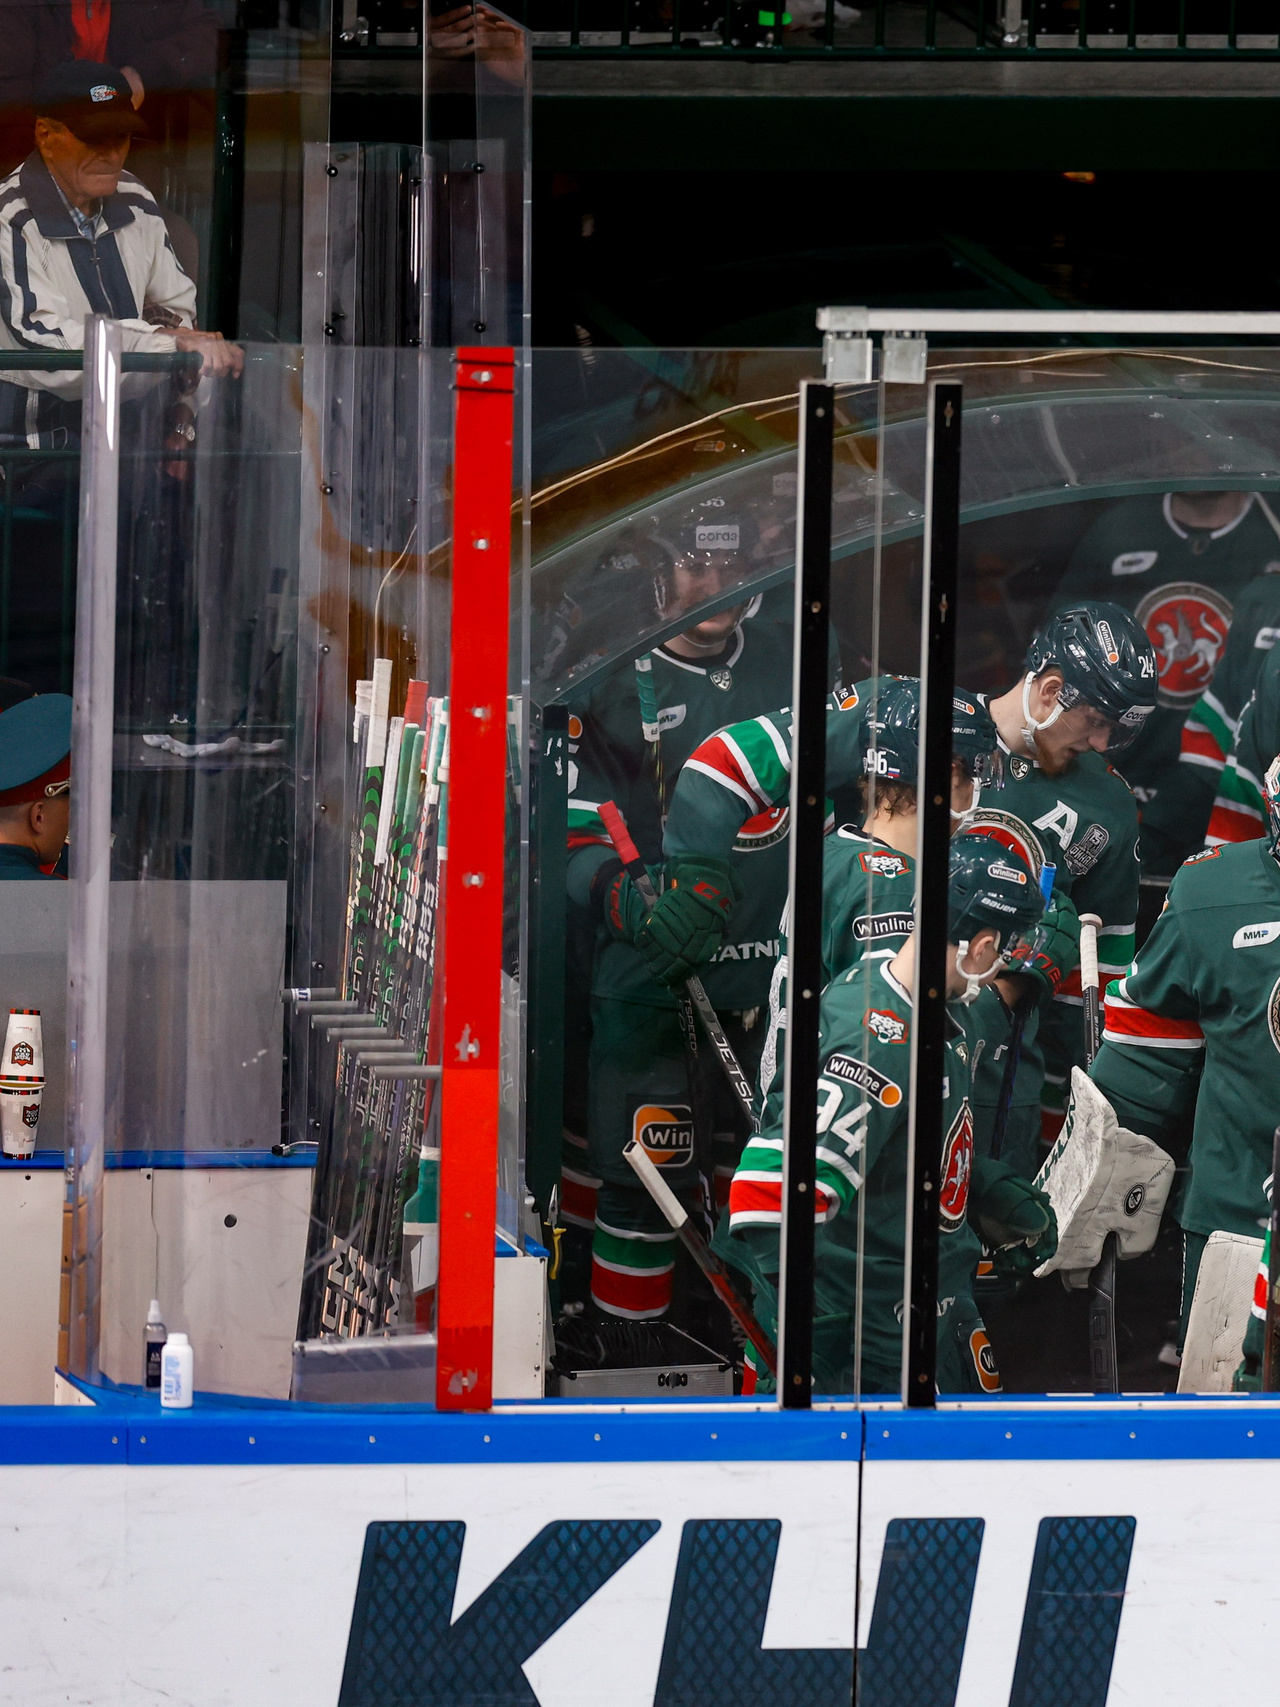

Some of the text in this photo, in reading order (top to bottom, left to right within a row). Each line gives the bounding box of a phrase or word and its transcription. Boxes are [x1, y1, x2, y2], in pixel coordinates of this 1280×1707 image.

[1099, 624, 1114, 653] Winline
[1138, 655, 1155, 678] 24
[951, 727, 977, 736] AUER
[866, 748, 888, 775] 96
[1032, 800, 1078, 850] A
[1069, 846, 1098, 870] ФИНАЛ
[992, 867, 1018, 881] Winline
[981, 897, 1018, 915] BAUER
[856, 917, 915, 938] Winline
[1243, 929, 1270, 941] МИР
[830, 1058, 881, 1092] Winline
